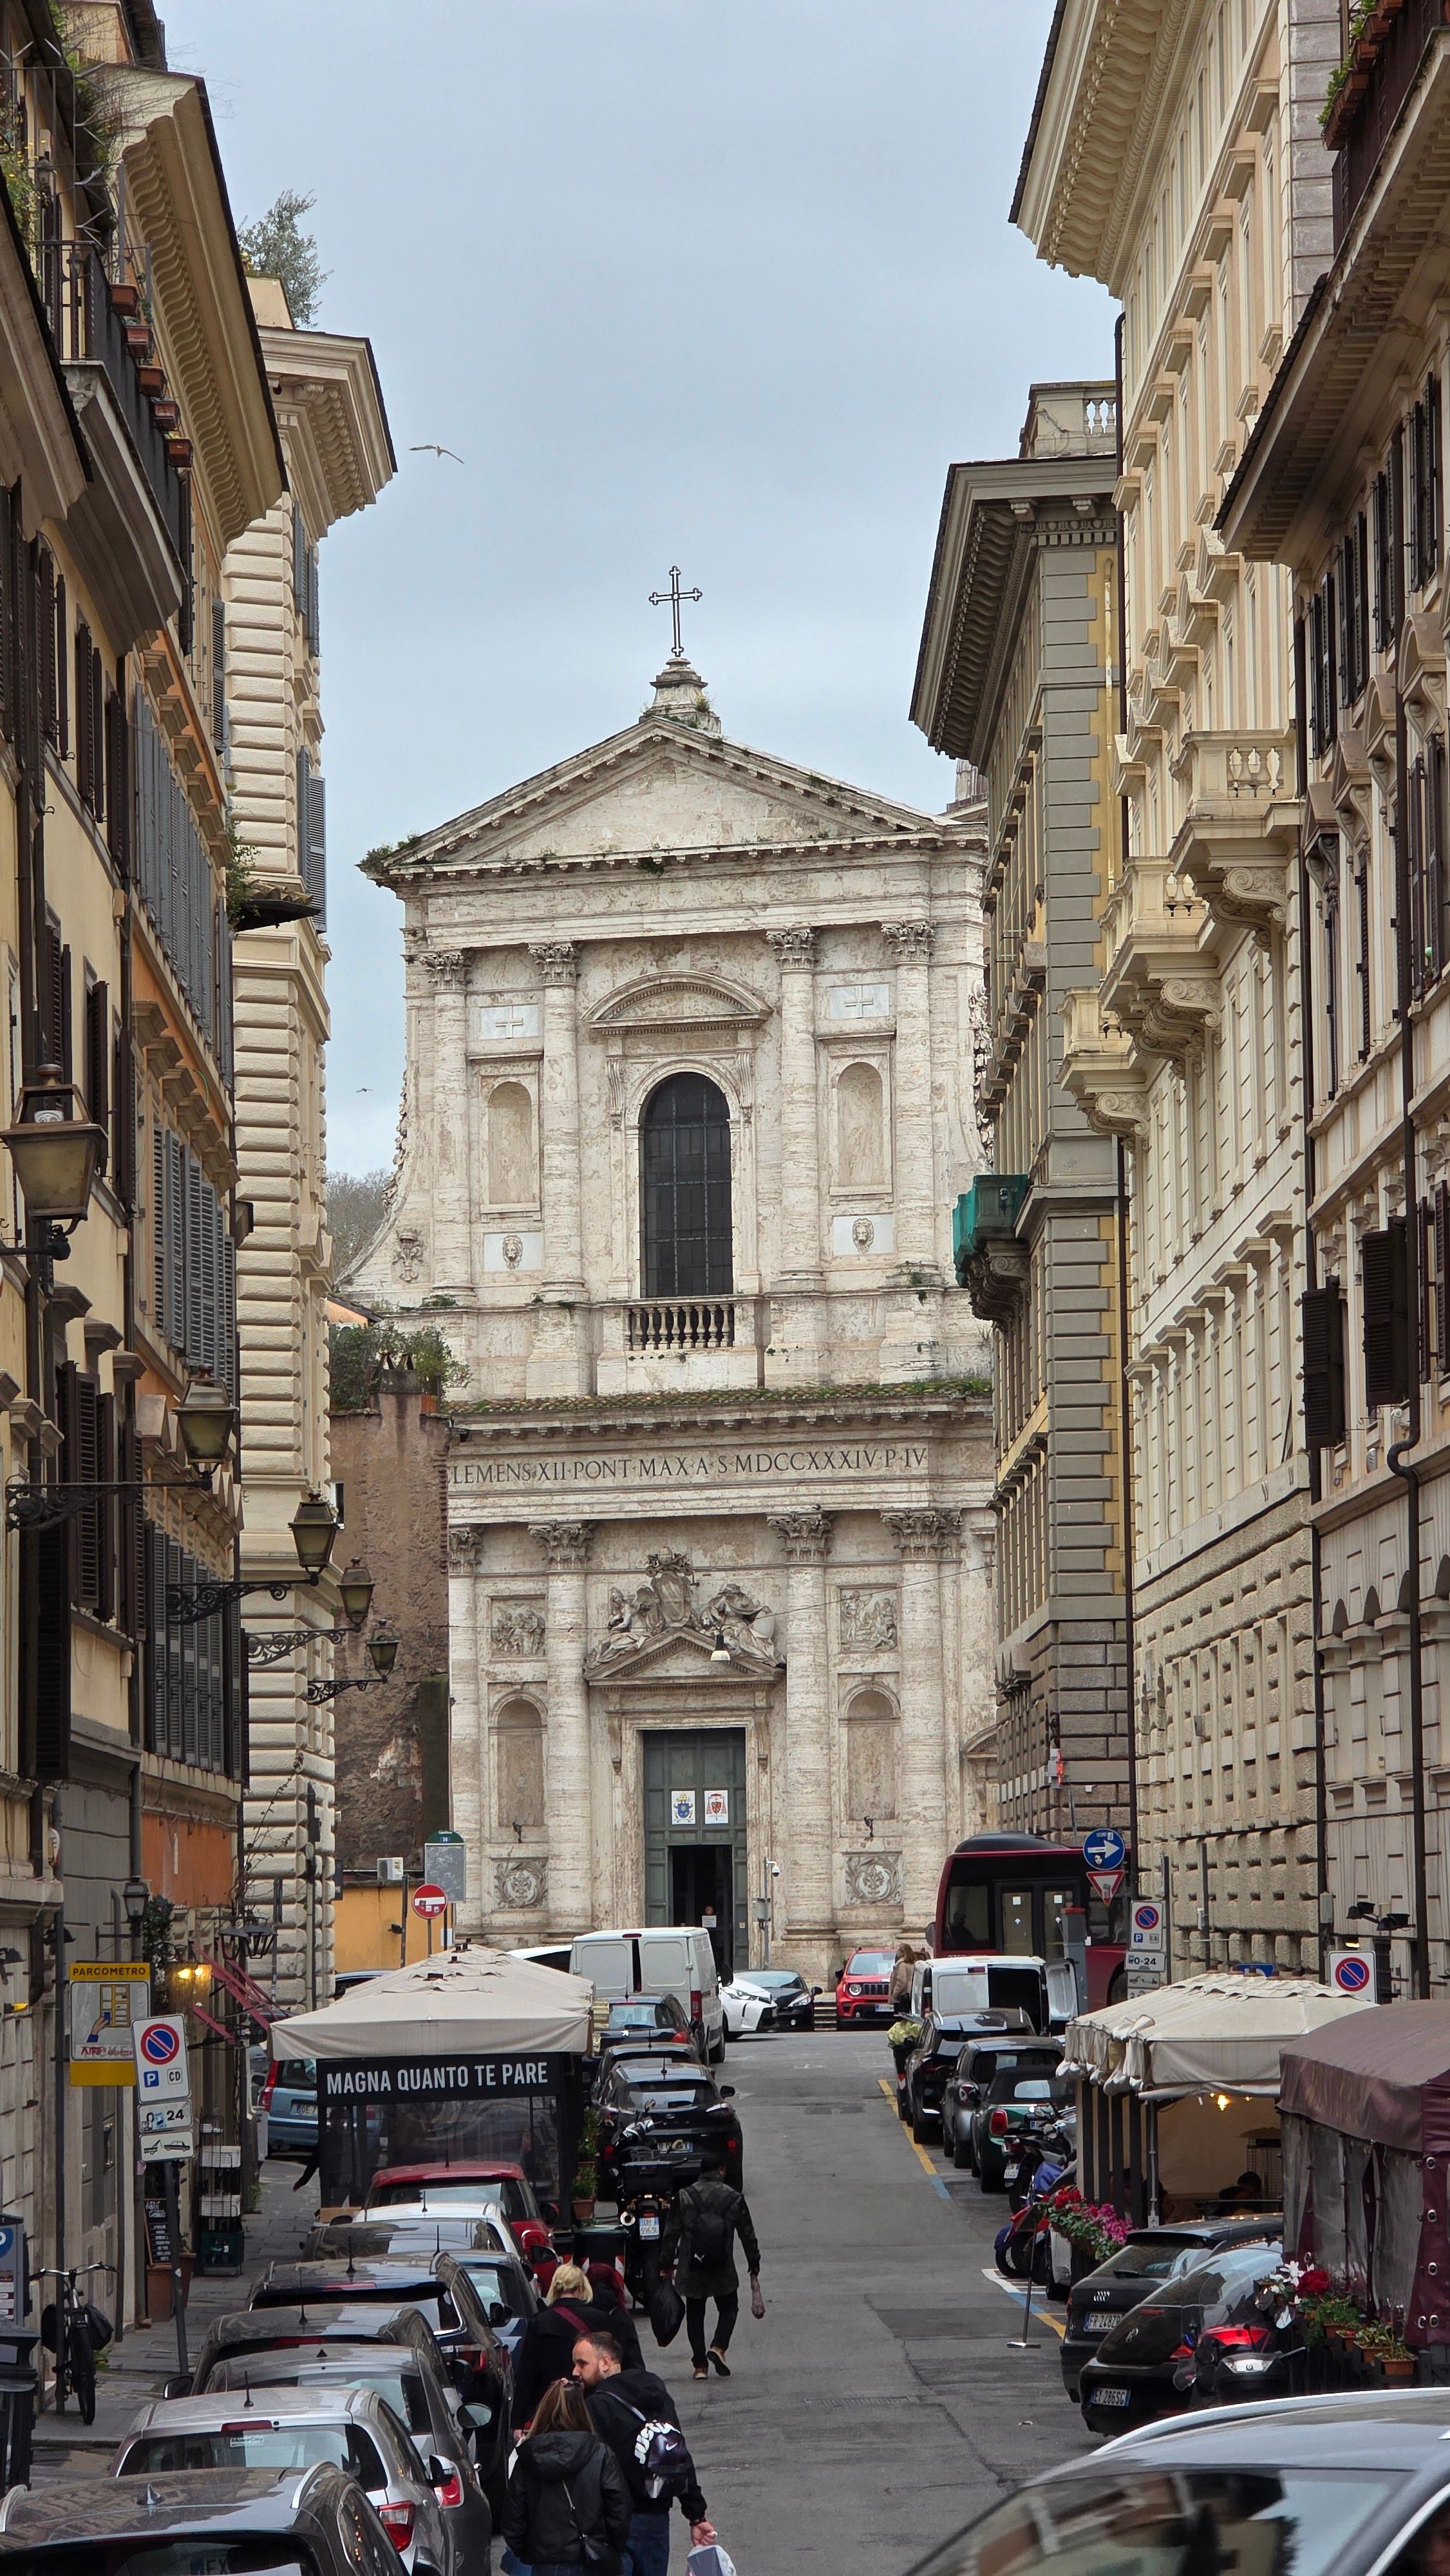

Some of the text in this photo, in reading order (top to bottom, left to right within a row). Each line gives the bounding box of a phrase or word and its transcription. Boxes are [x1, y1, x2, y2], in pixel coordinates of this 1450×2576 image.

[538, 1461, 567, 1481] XII
[572, 1459, 632, 1480] PONT
[638, 1456, 690, 1477] MAX
[735, 1449, 878, 1473] MDCCXXXIV
[1134, 1956, 1156, 1965] 0-24
[72, 1967, 146, 1976] PARCOMETRO
[147, 2070, 181, 2086] P CD
[326, 2062, 548, 2095] MAGNA QUANTO TE PARE
